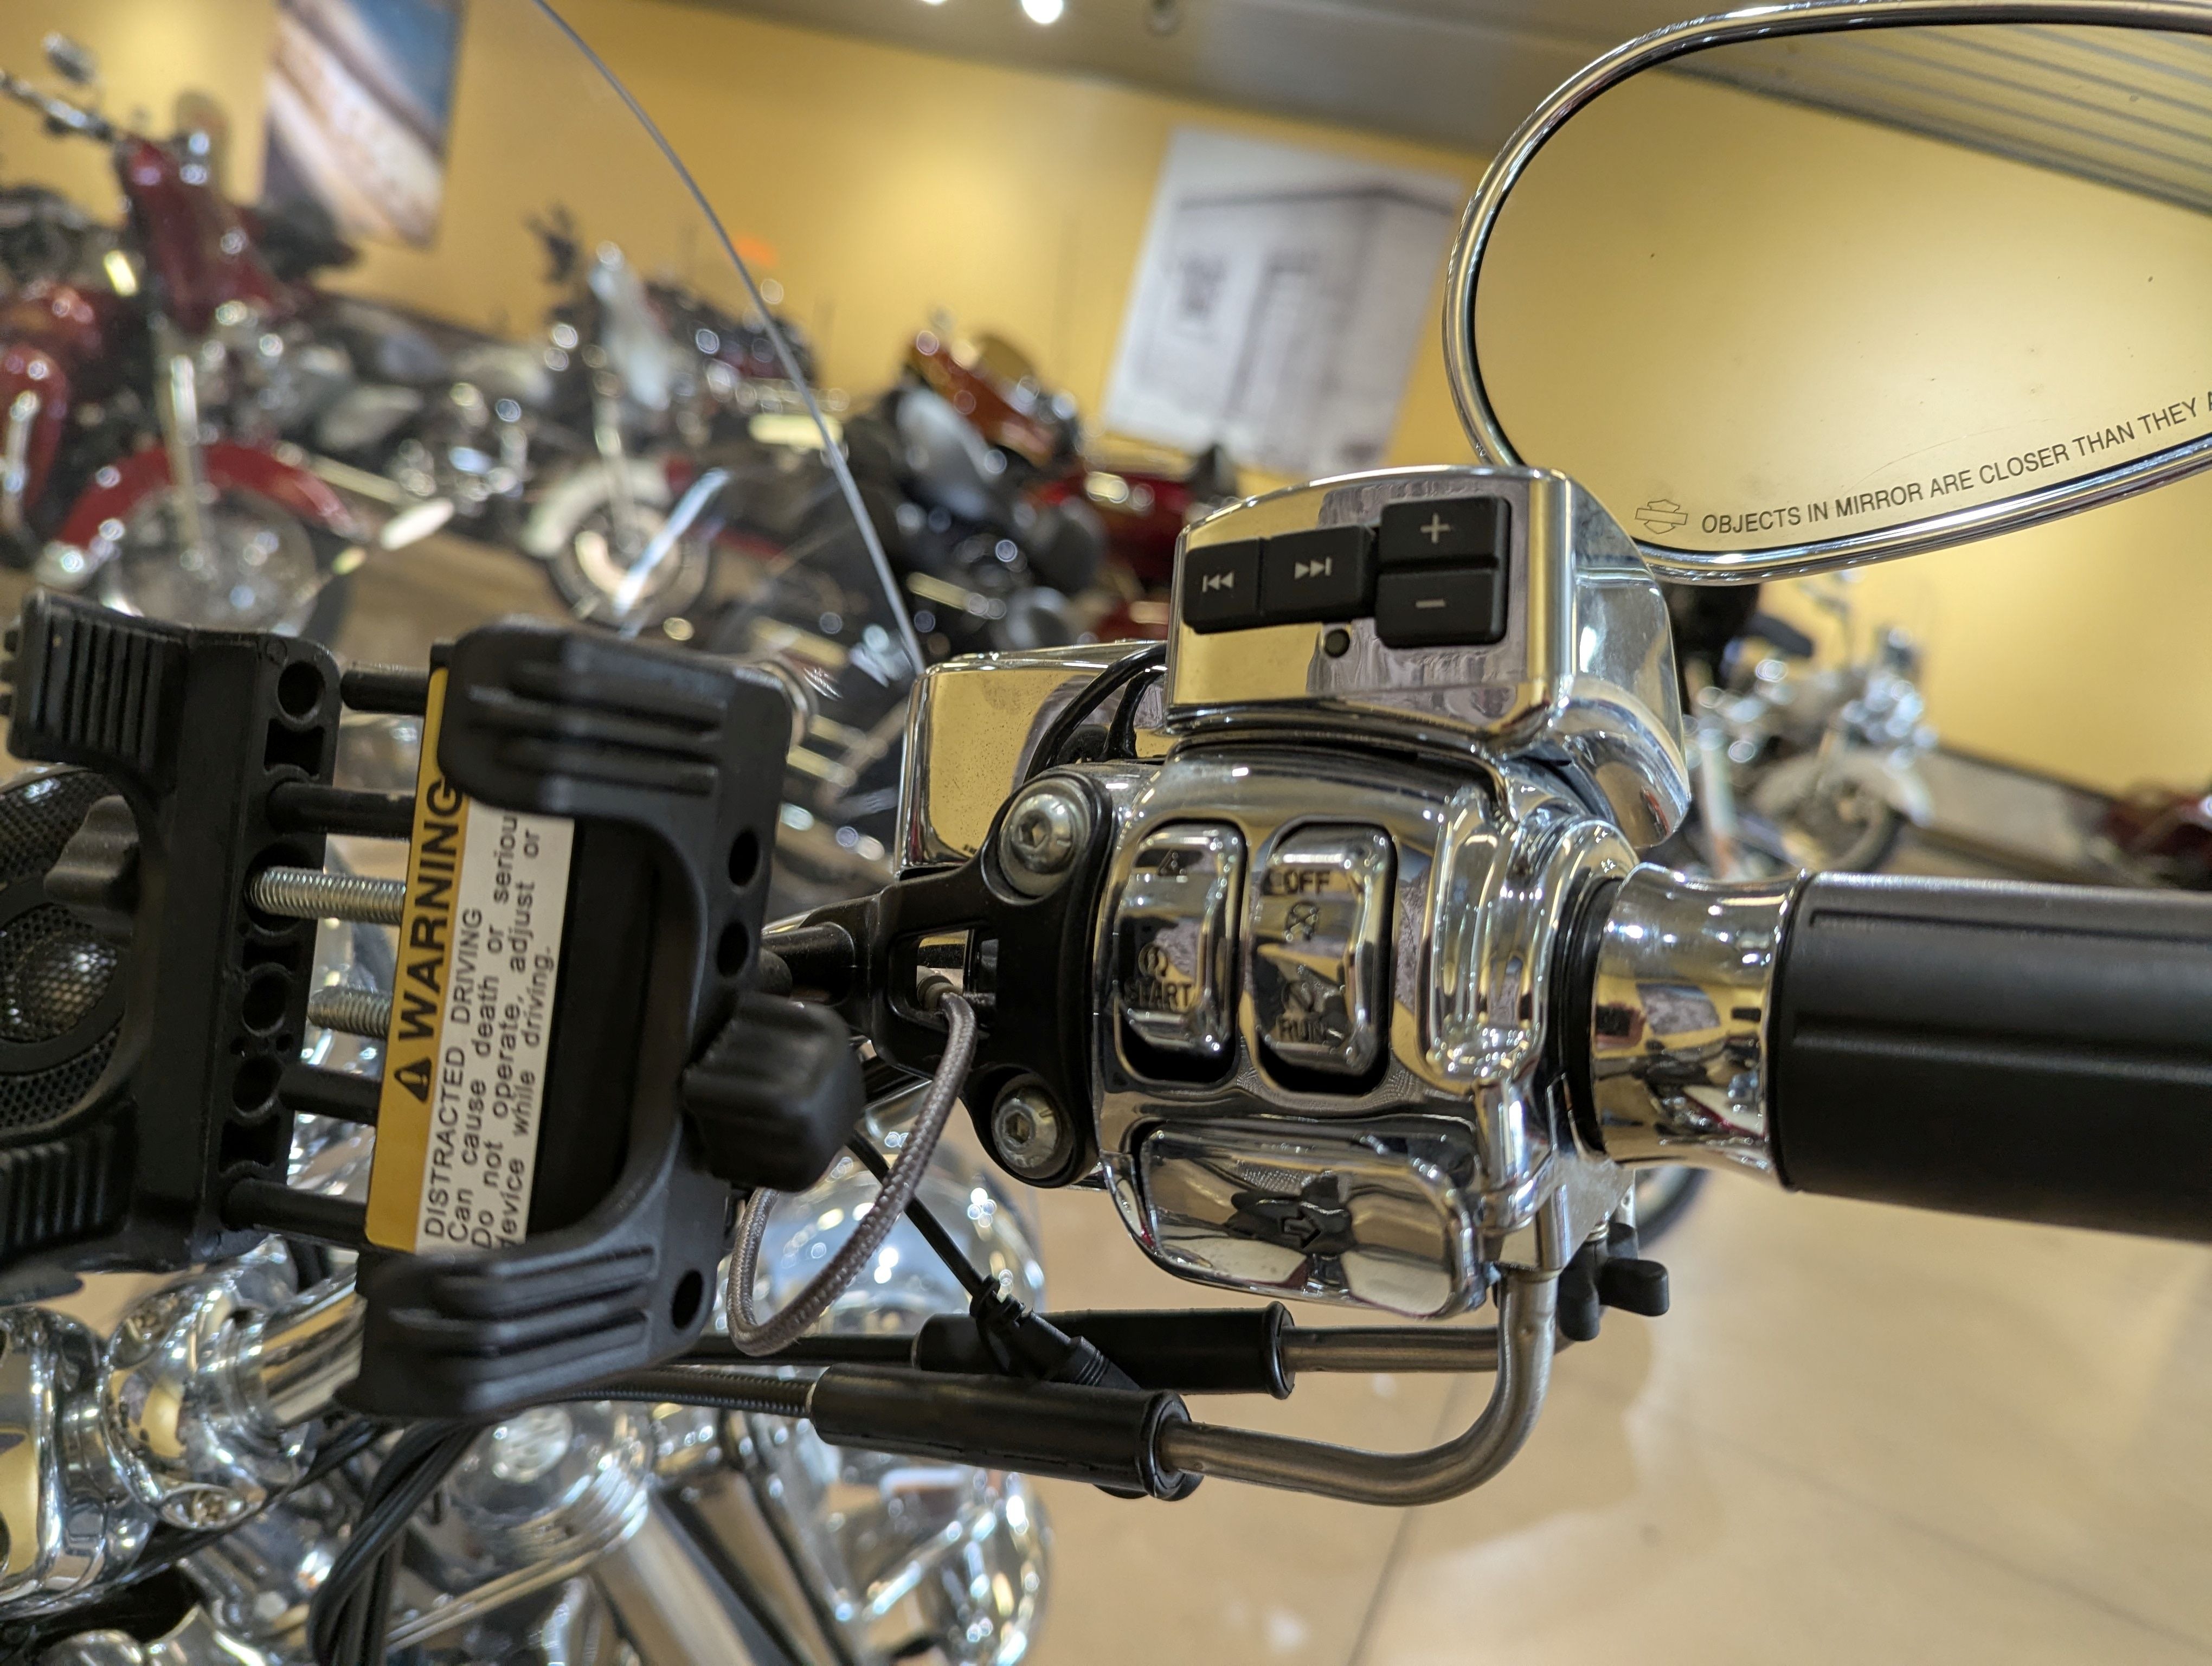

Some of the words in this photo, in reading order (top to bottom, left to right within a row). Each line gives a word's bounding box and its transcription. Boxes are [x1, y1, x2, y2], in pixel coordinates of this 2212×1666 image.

[1702, 507, 1801, 534] OBJECTS
[1808, 501, 1828, 522] IN
[1835, 482, 1923, 517] MIRROR
[1931, 469, 1974, 498] ARE
[1979, 444, 2070, 484] CLOSER
[2072, 421, 2135, 456] THAN
[2137, 397, 2196, 434] THEY
[494, 815, 517, 905] seriou
[524, 828, 539, 858] or
[1284, 869, 1330, 895] OFF
[398, 778, 462, 1042] WARNING
[487, 924, 504, 954] or
[508, 881, 535, 973] adjust
[471, 976, 499, 1058] death
[521, 946, 554, 1048] driving.
[1124, 978, 1192, 1012] START
[425, 1046, 465, 1238] DISTRACTED
[451, 908, 483, 1024] DRIVING
[492, 995, 524, 1119] operate,
[462, 1079, 486, 1165] cause
[510, 1070, 536, 1136] while
[483, 1140, 503, 1188] not
[448, 1188, 473, 1242] Can
[471, 1210, 494, 1248] Do
